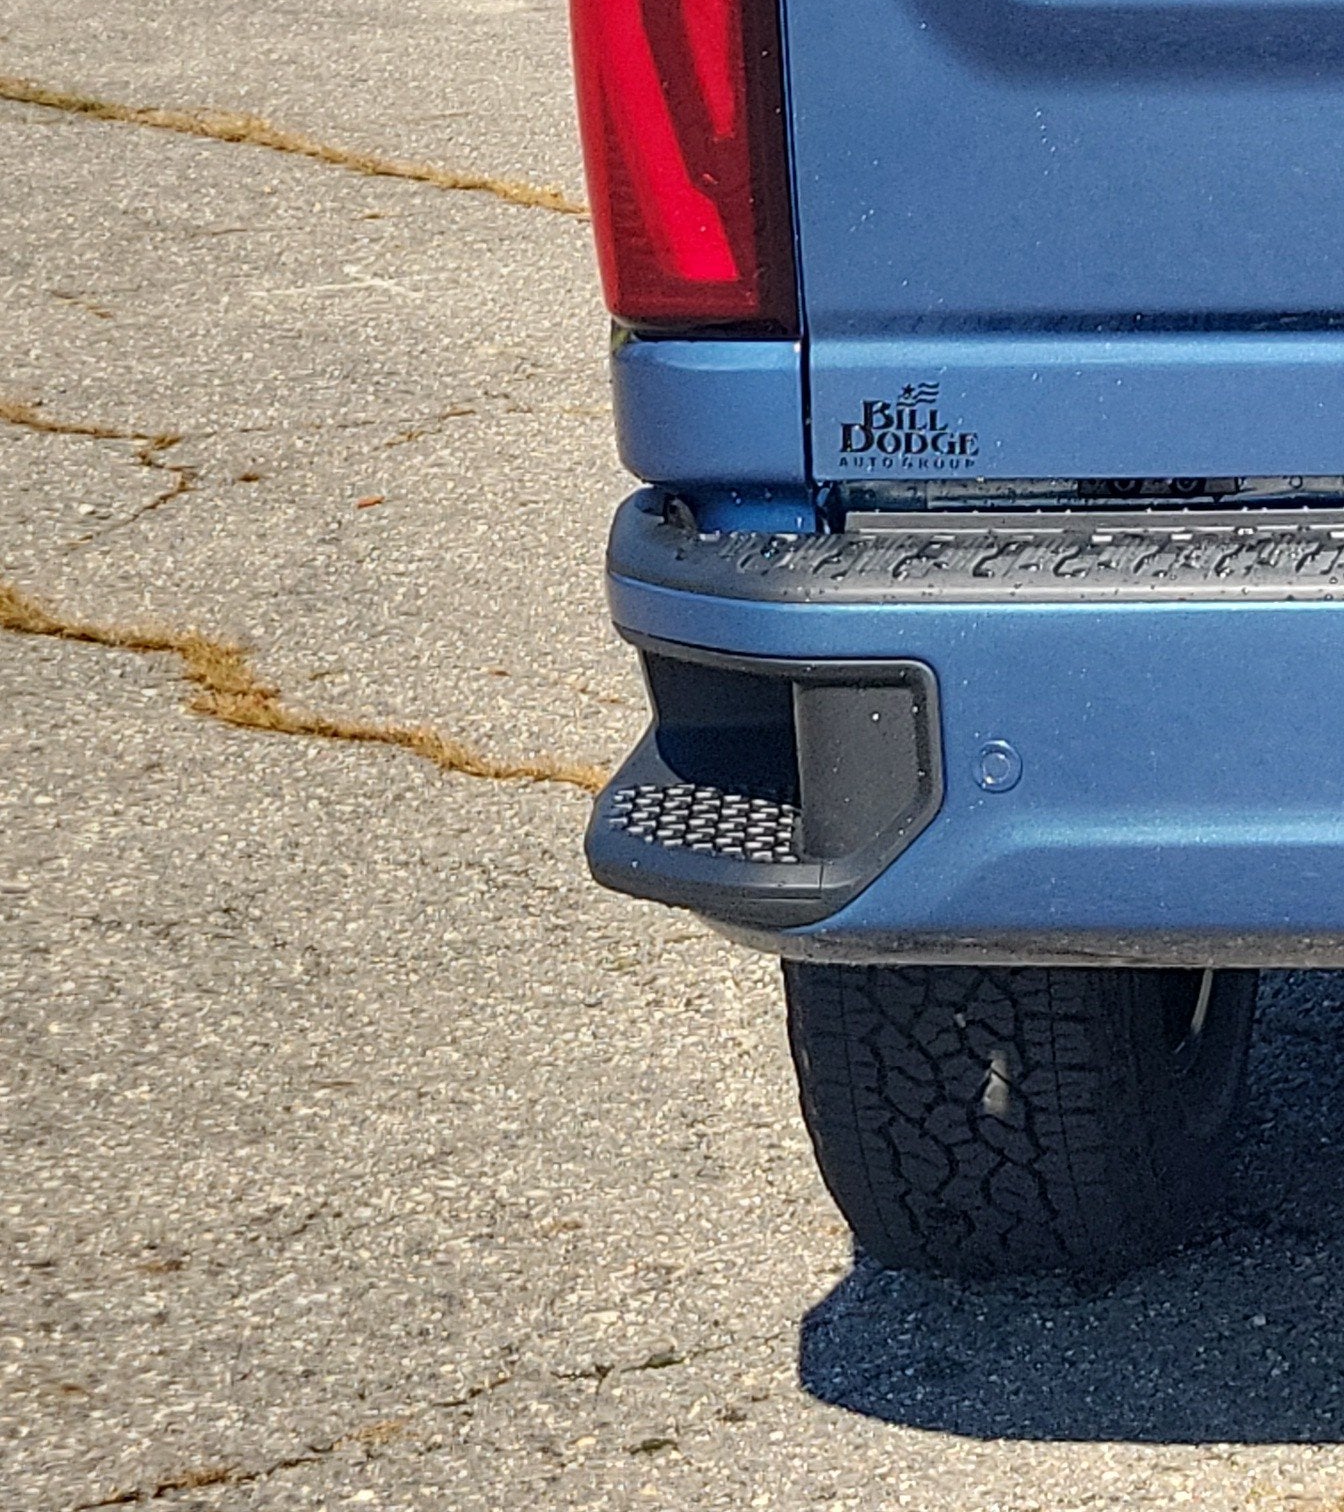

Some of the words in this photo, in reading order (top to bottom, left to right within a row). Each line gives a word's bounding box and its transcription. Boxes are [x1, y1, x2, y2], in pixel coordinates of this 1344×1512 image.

[861, 399, 949, 432] BILL
[839, 422, 980, 456] DODGE
[838, 456, 893, 470] AUTO
[902, 455, 977, 470] GROUP
